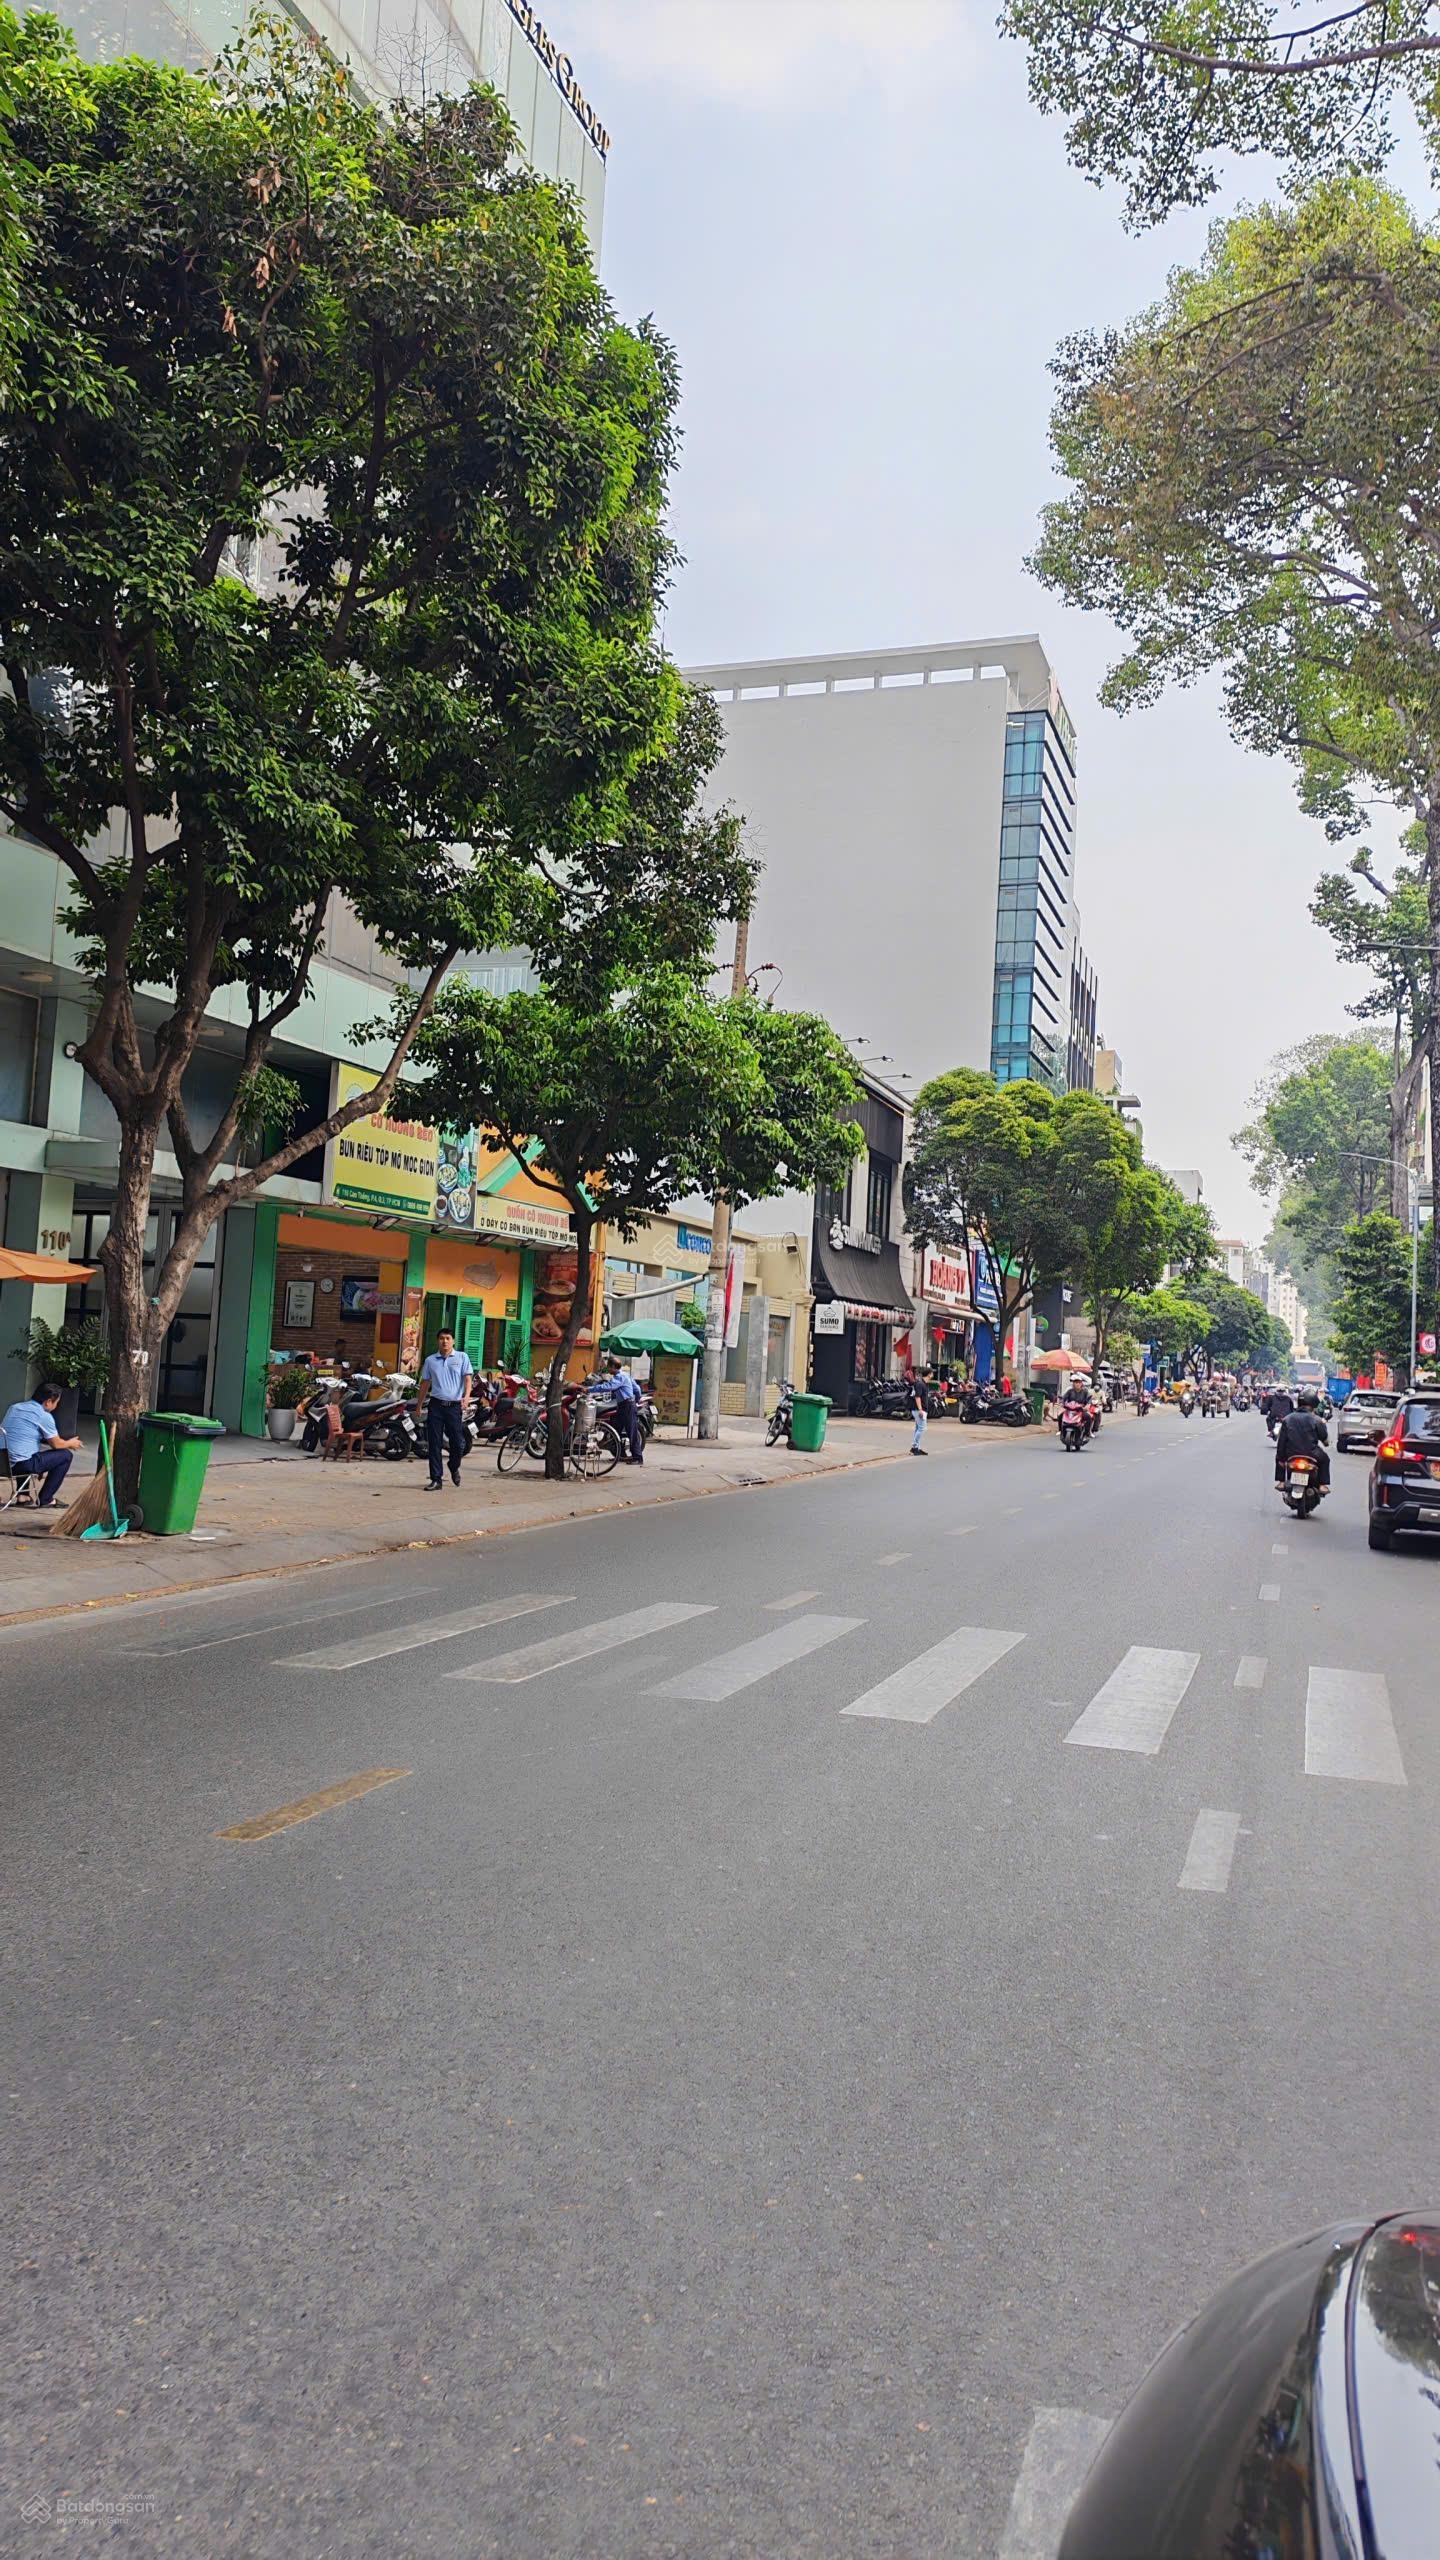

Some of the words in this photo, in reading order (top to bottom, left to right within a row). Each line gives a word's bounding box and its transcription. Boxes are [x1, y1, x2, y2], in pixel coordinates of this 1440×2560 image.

[339, 1134, 355, 1158] BÚN
[376, 1144, 389, 1166] TÓP
[506, 1205, 525, 1219] QUÁN
[820, 1317, 839, 1325] SUMO
